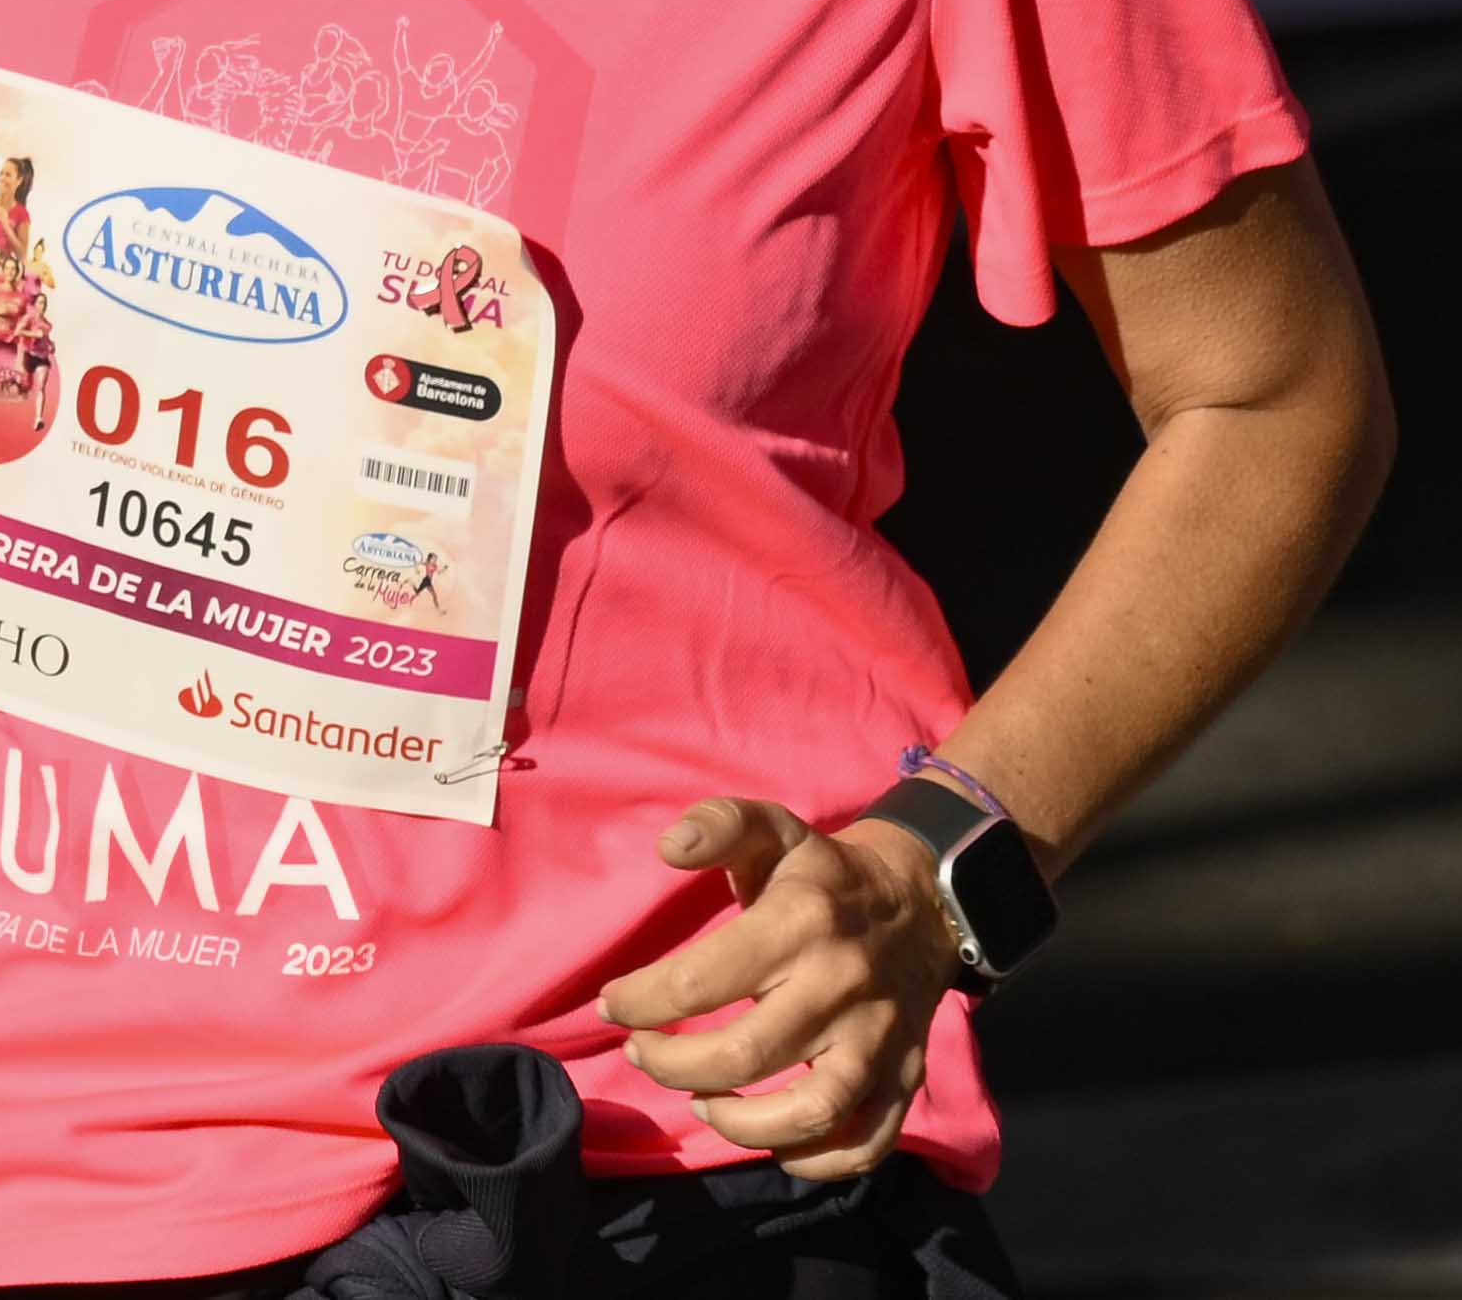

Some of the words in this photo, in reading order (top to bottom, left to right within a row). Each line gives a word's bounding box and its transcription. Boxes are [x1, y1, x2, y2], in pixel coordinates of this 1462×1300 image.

[80, 215, 322, 326] ASTURIANA
[133, 221, 219, 257] CENTRAL
[230, 249, 320, 283] LECHERA
[382, 251, 411, 271] TU
[76, 365, 292, 489] 016
[416, 383, 485, 409] Barcelona
[141, 462, 206, 489] VIOLENCIA
[210, 481, 226, 495] DE
[89, 481, 253, 566] 10645
[343, 557, 401, 582] Carrera
[88, 564, 138, 603] DE
[144, 580, 194, 620] LA
[202, 602, 333, 658] MUJER
[343, 635, 437, 678] 2023
[230, 692, 443, 764] Santander
[25, 919, 69, 954] DE
[78, 931, 119, 957] LA
[129, 927, 240, 968] MUJER
[282, 942, 378, 978] 2023
